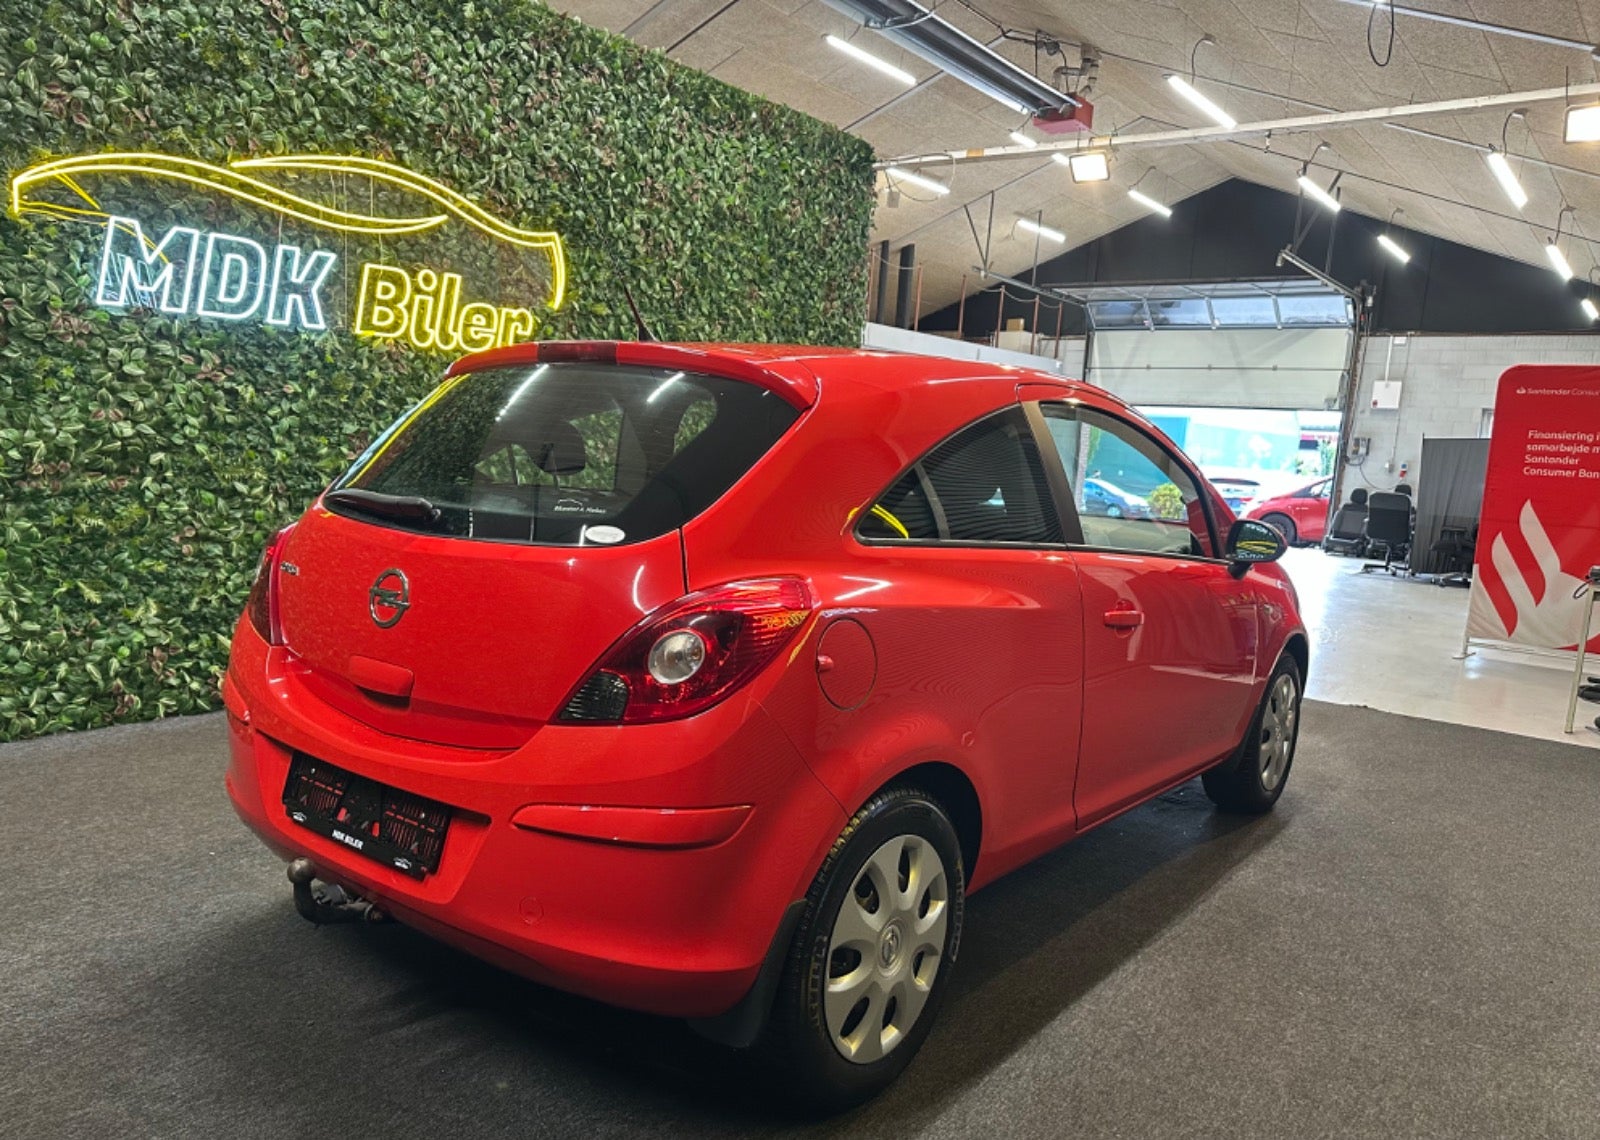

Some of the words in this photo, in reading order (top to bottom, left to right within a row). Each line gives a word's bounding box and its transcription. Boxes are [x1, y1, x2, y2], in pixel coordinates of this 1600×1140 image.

[95, 215, 337, 331] MDK
[354, 261, 535, 352] Biler
[1526, 387, 1570, 396] Santander
[1528, 430, 1595, 443] Finansiering
[1526, 443, 1590, 455] samarbejde
[1524, 454, 1580, 465] Santander
[1523, 466, 1576, 478] Consumer
